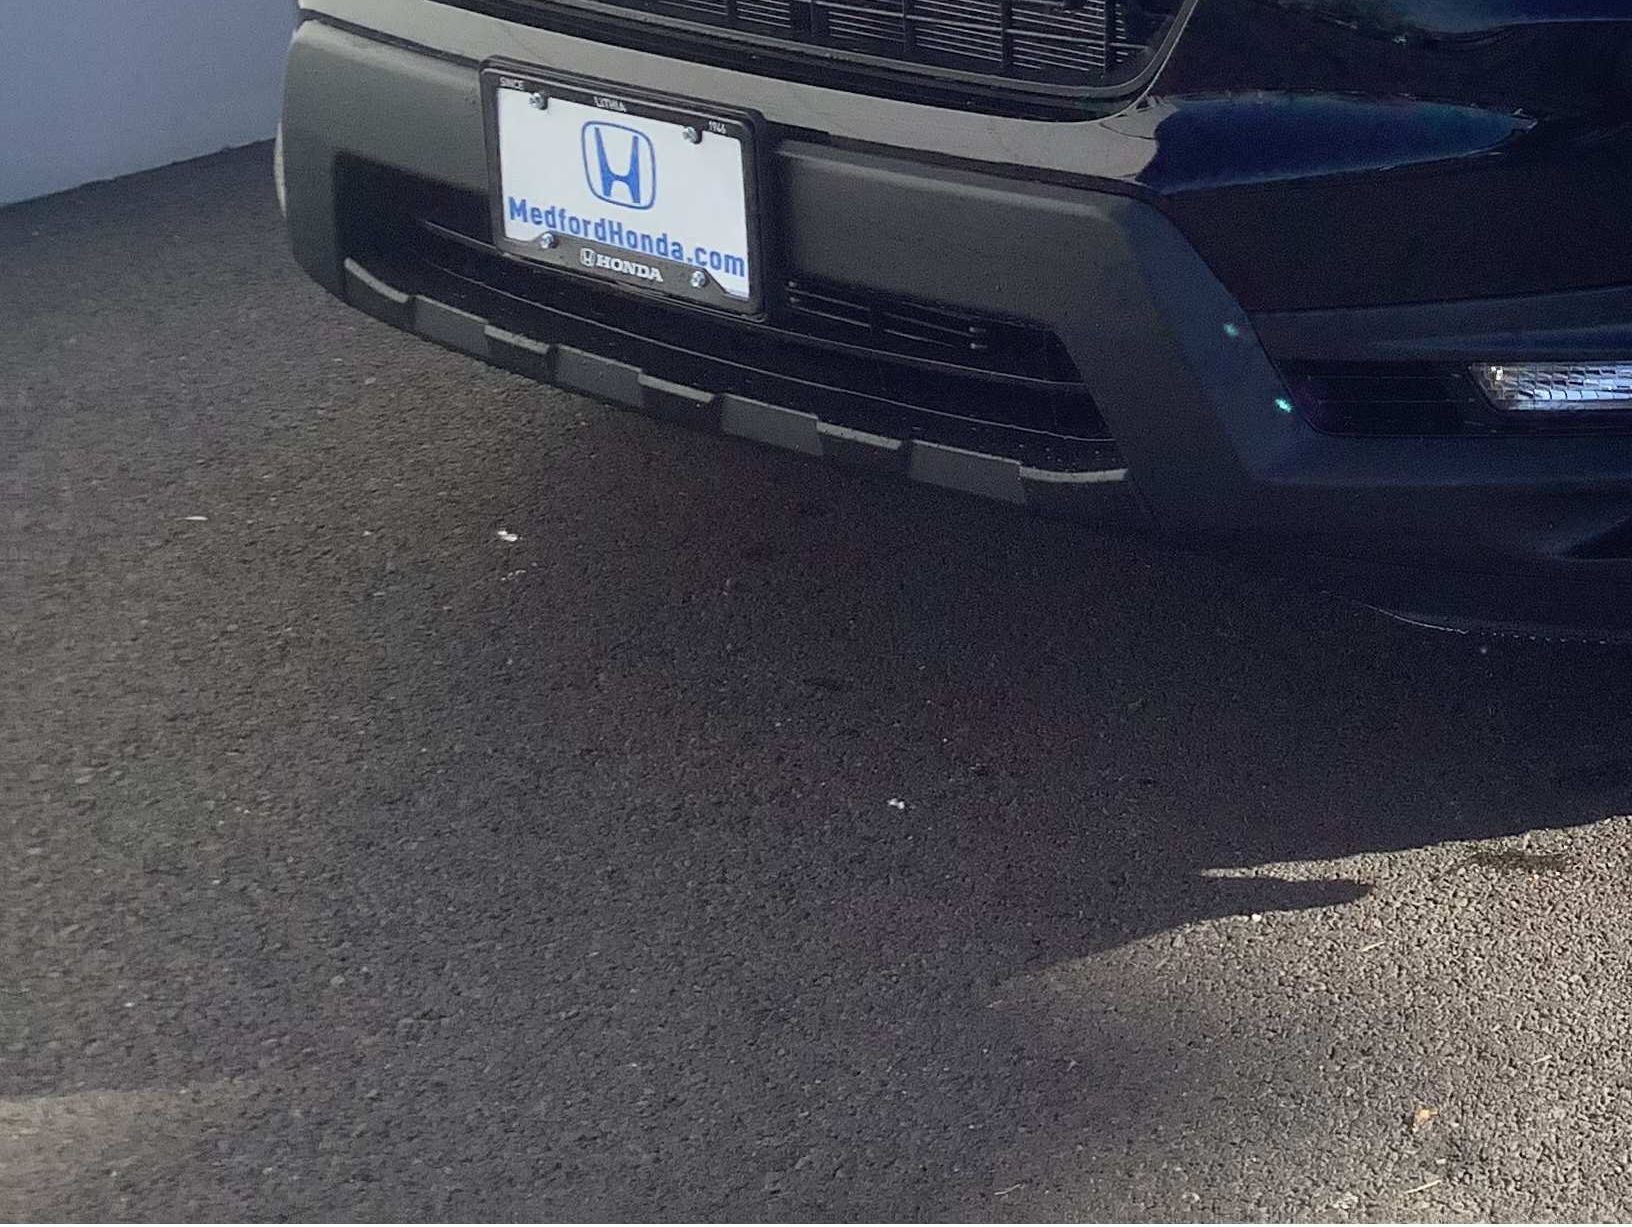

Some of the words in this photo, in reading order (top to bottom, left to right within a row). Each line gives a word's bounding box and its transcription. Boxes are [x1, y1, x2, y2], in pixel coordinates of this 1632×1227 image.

[593, 95, 627, 113] LITHIA
[507, 195, 746, 278] MedfordHonda.com
[595, 253, 664, 283] HONDA
